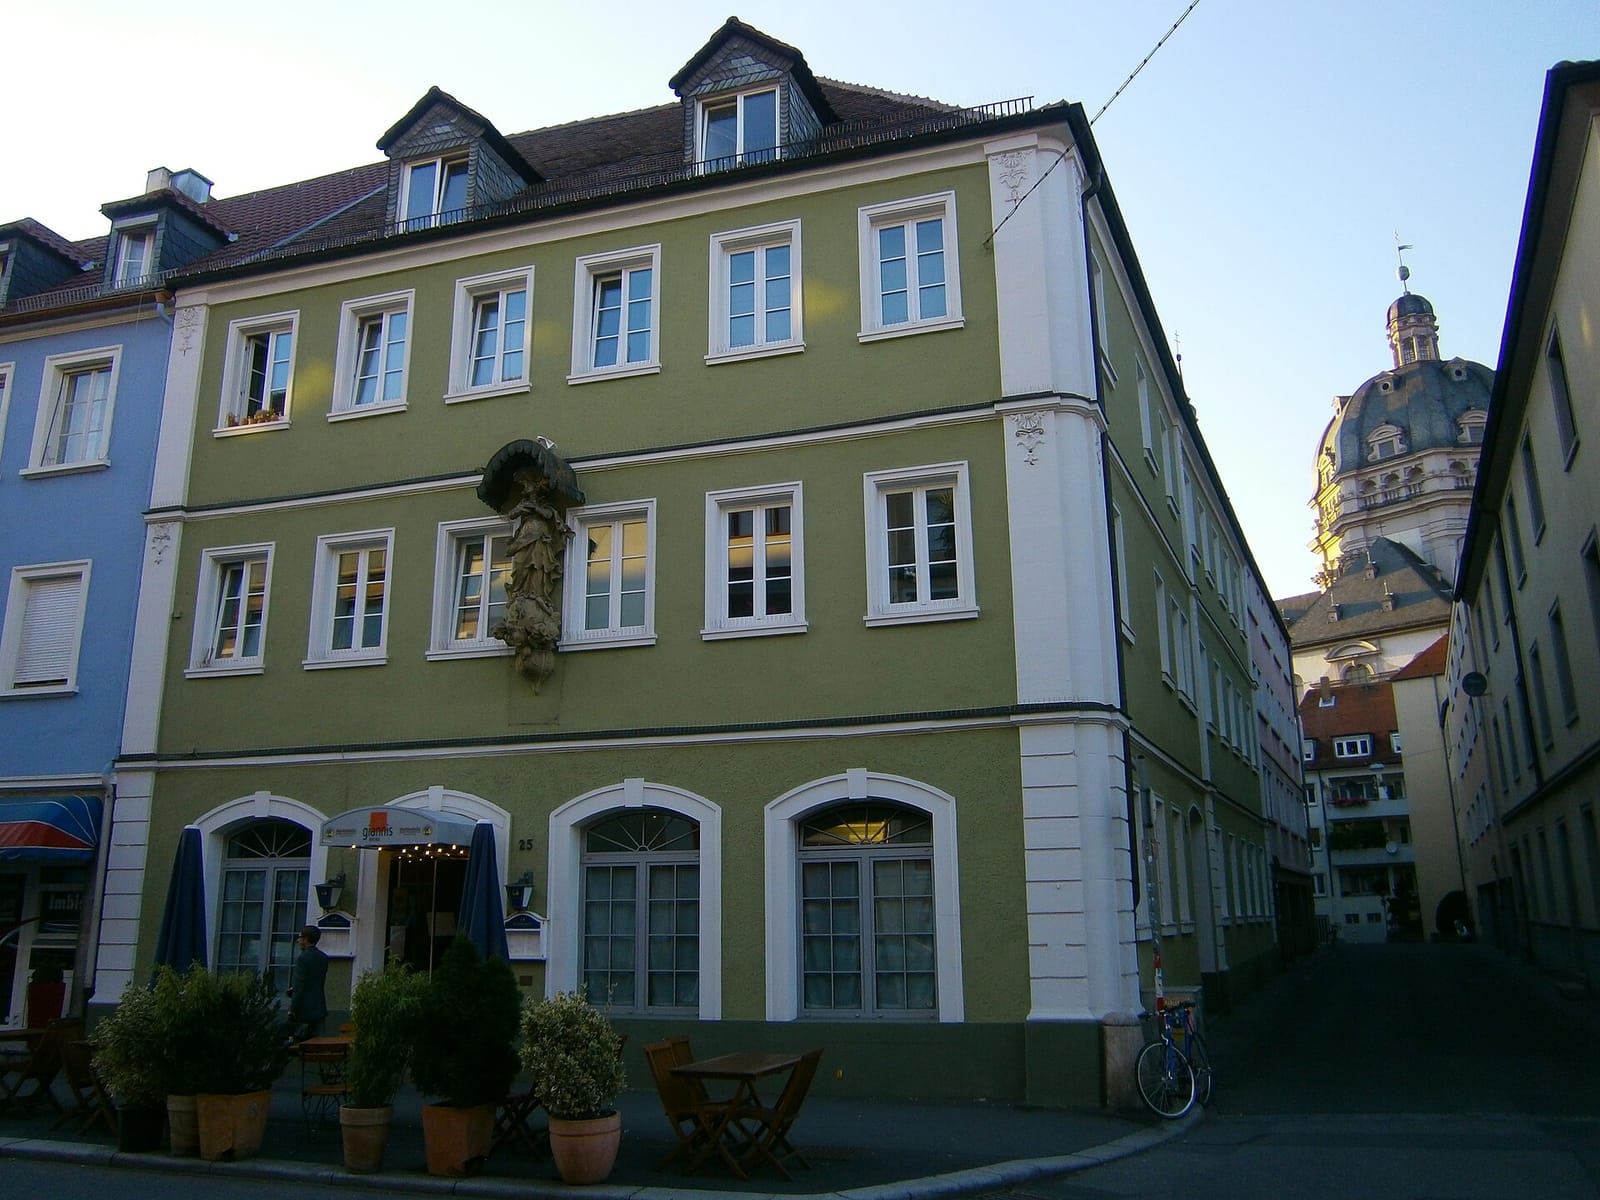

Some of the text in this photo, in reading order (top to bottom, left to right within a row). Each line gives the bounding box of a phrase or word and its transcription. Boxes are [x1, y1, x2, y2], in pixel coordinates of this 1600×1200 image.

[362, 824, 393, 841] giannis
[518, 839, 534, 851] 25
[48, 893, 82, 911] Imbi
